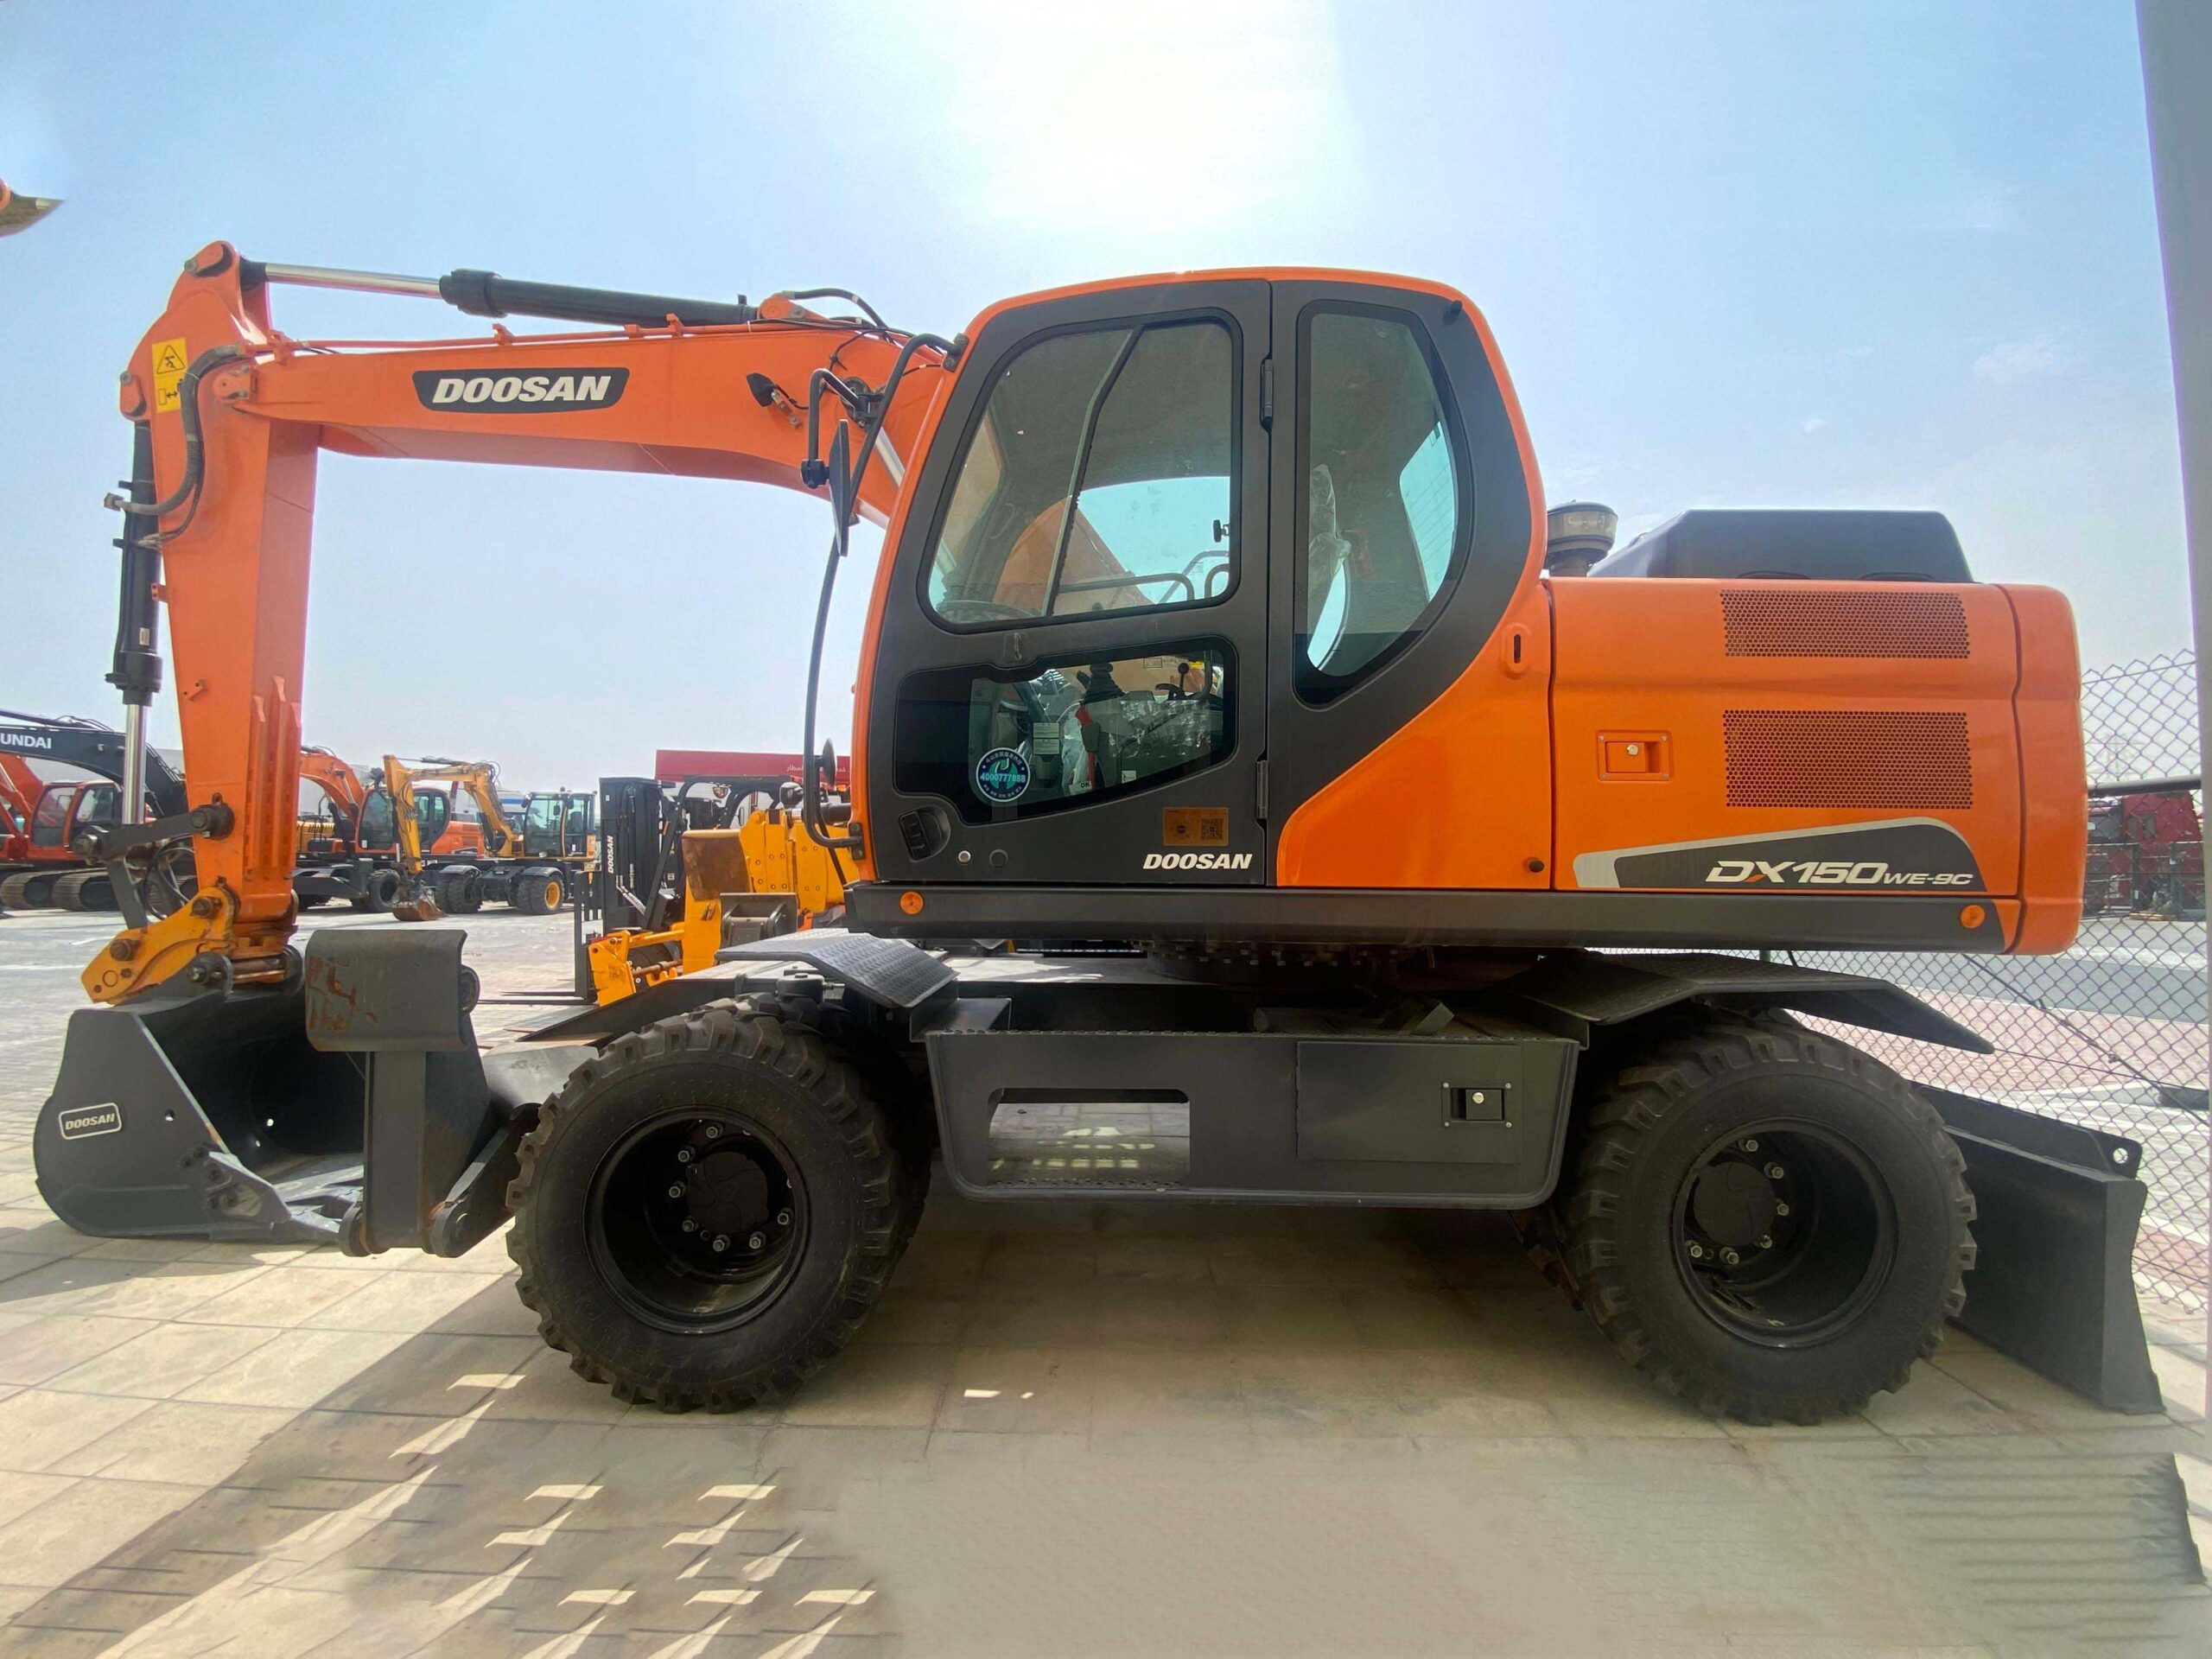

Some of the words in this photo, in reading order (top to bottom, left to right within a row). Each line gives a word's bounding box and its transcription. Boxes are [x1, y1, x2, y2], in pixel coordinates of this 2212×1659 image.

[433, 376, 611, 404] DOOSAN
[0, 733, 52, 749] UNDAI
[1143, 854, 1252, 869] DOOSAN
[65, 1113, 115, 1130] DOOSAN
